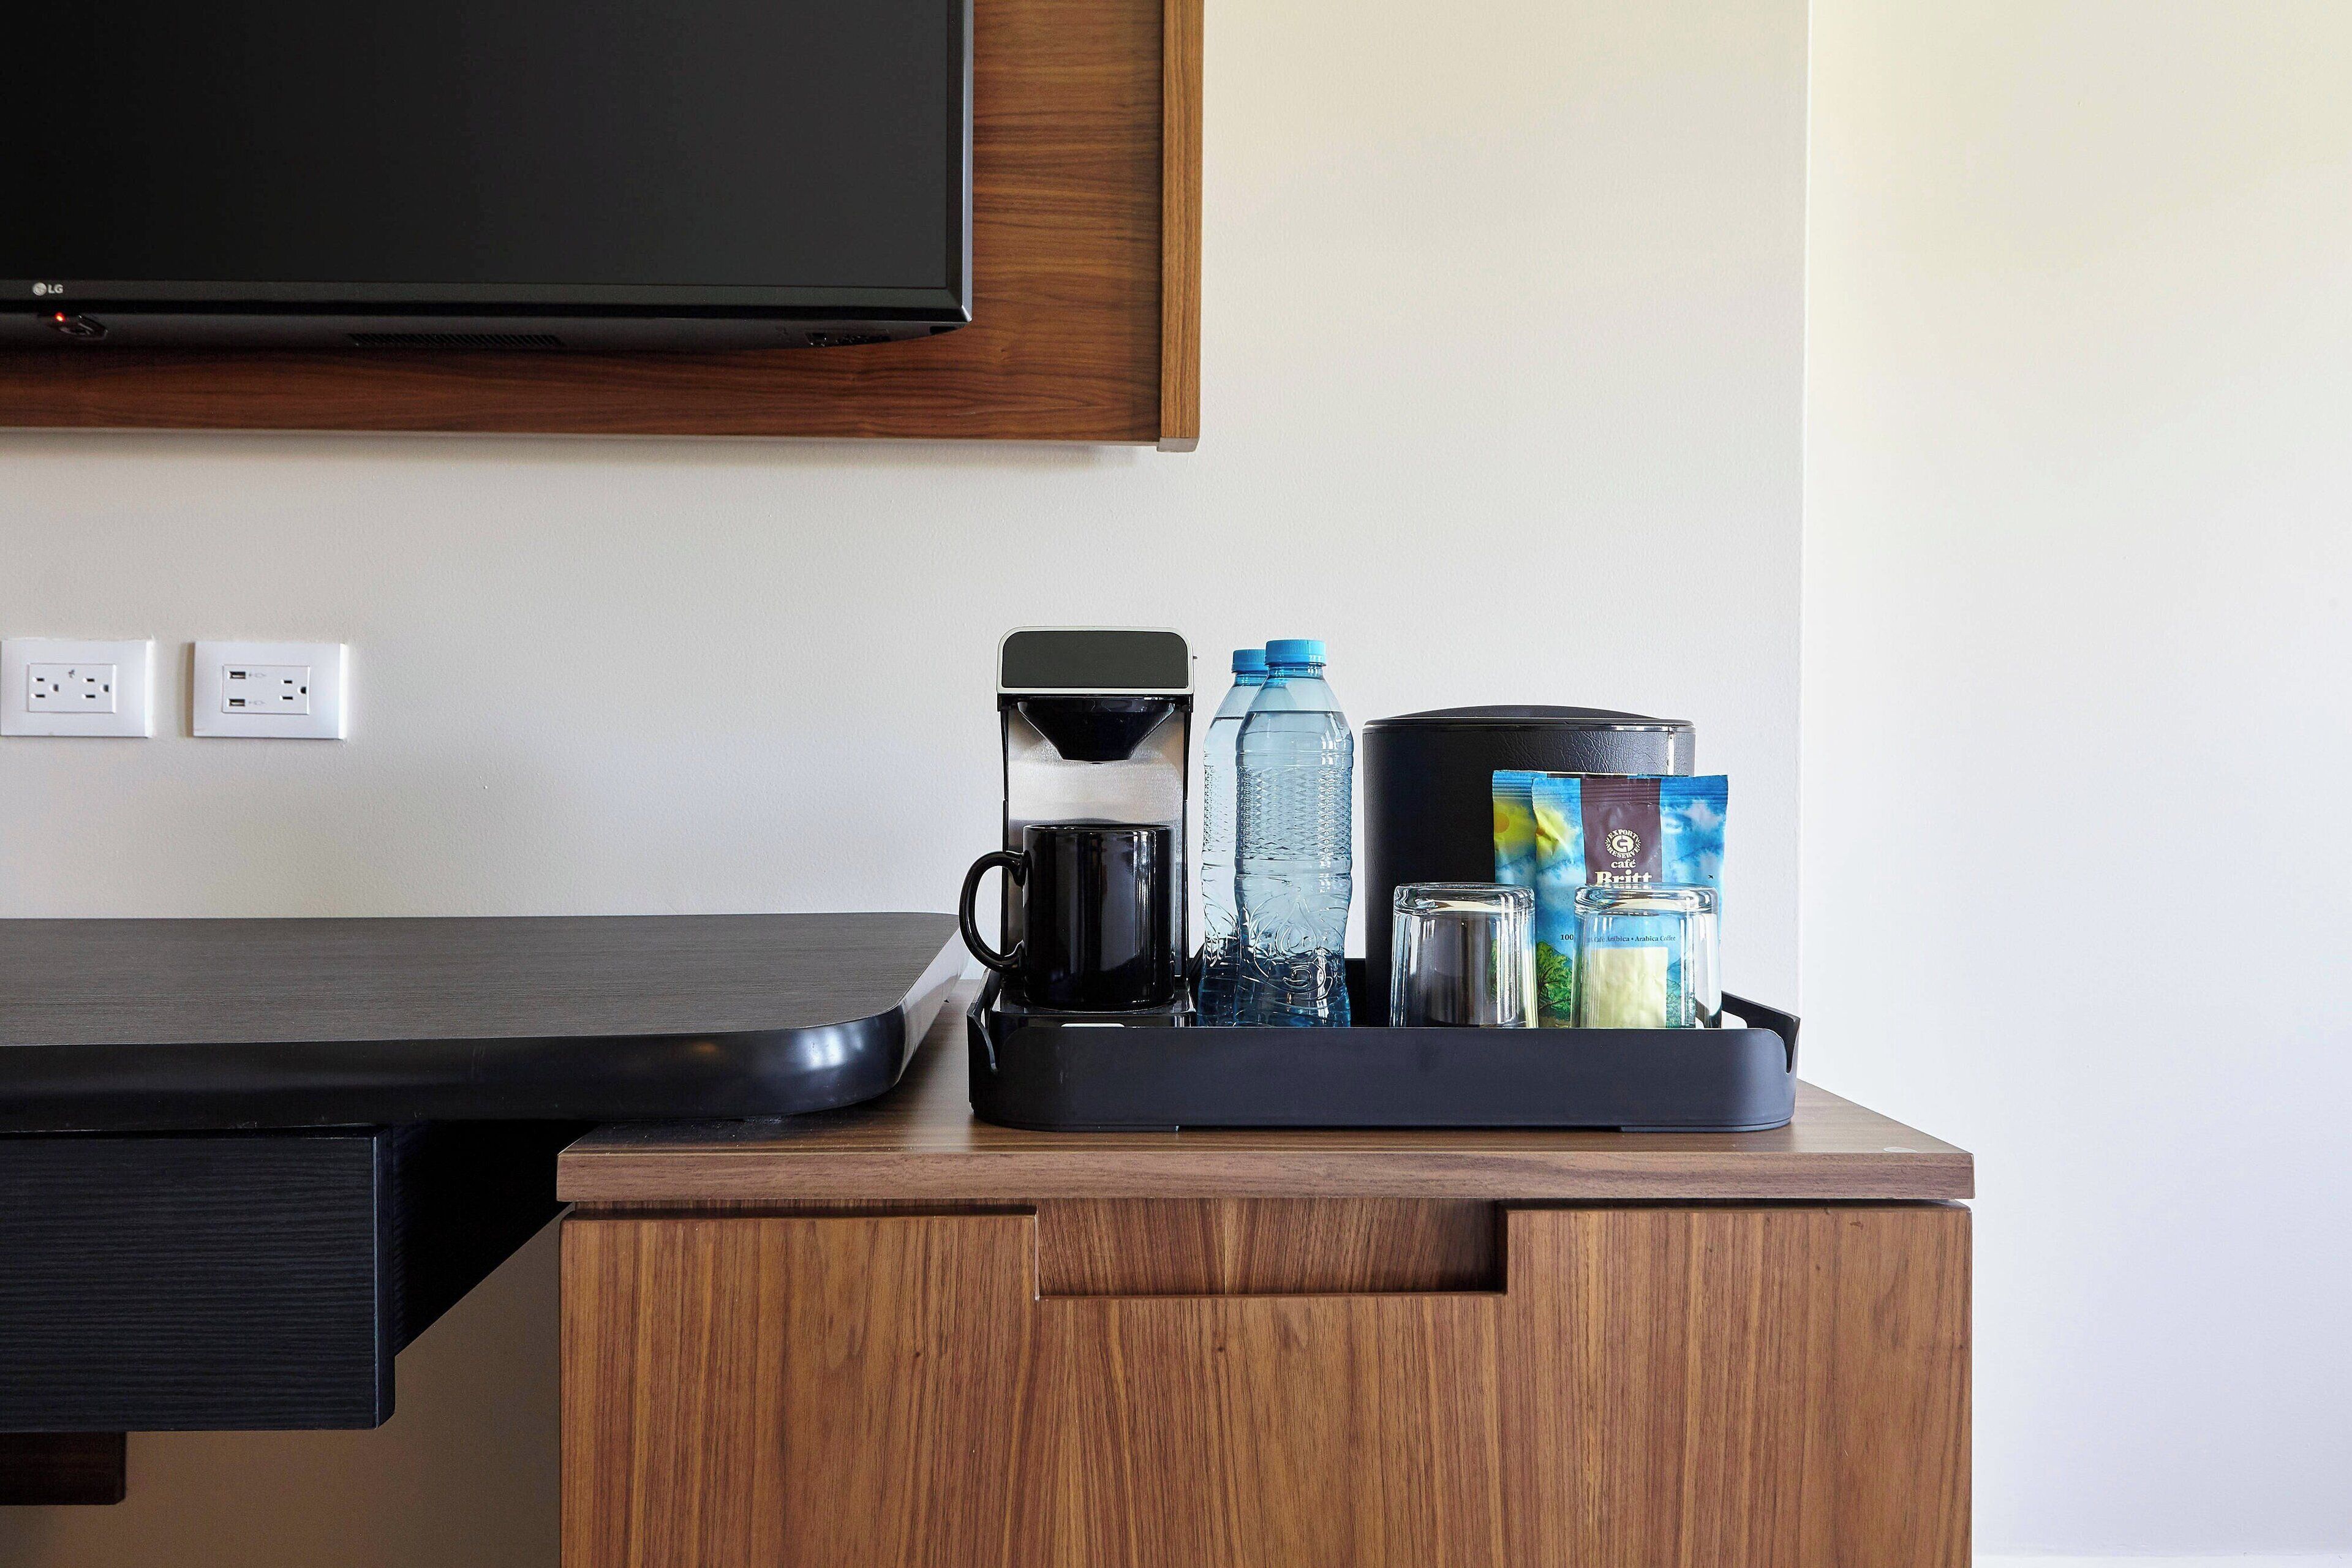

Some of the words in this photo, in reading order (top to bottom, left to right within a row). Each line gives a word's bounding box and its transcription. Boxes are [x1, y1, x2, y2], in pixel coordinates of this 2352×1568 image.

[48, 284, 64, 294] LG
[1608, 829, 1638, 839] EXPORT
[1607, 846, 1640, 858] RESERVE
[1611, 859, 1636, 869] café
[1594, 869, 1653, 886] Britt
